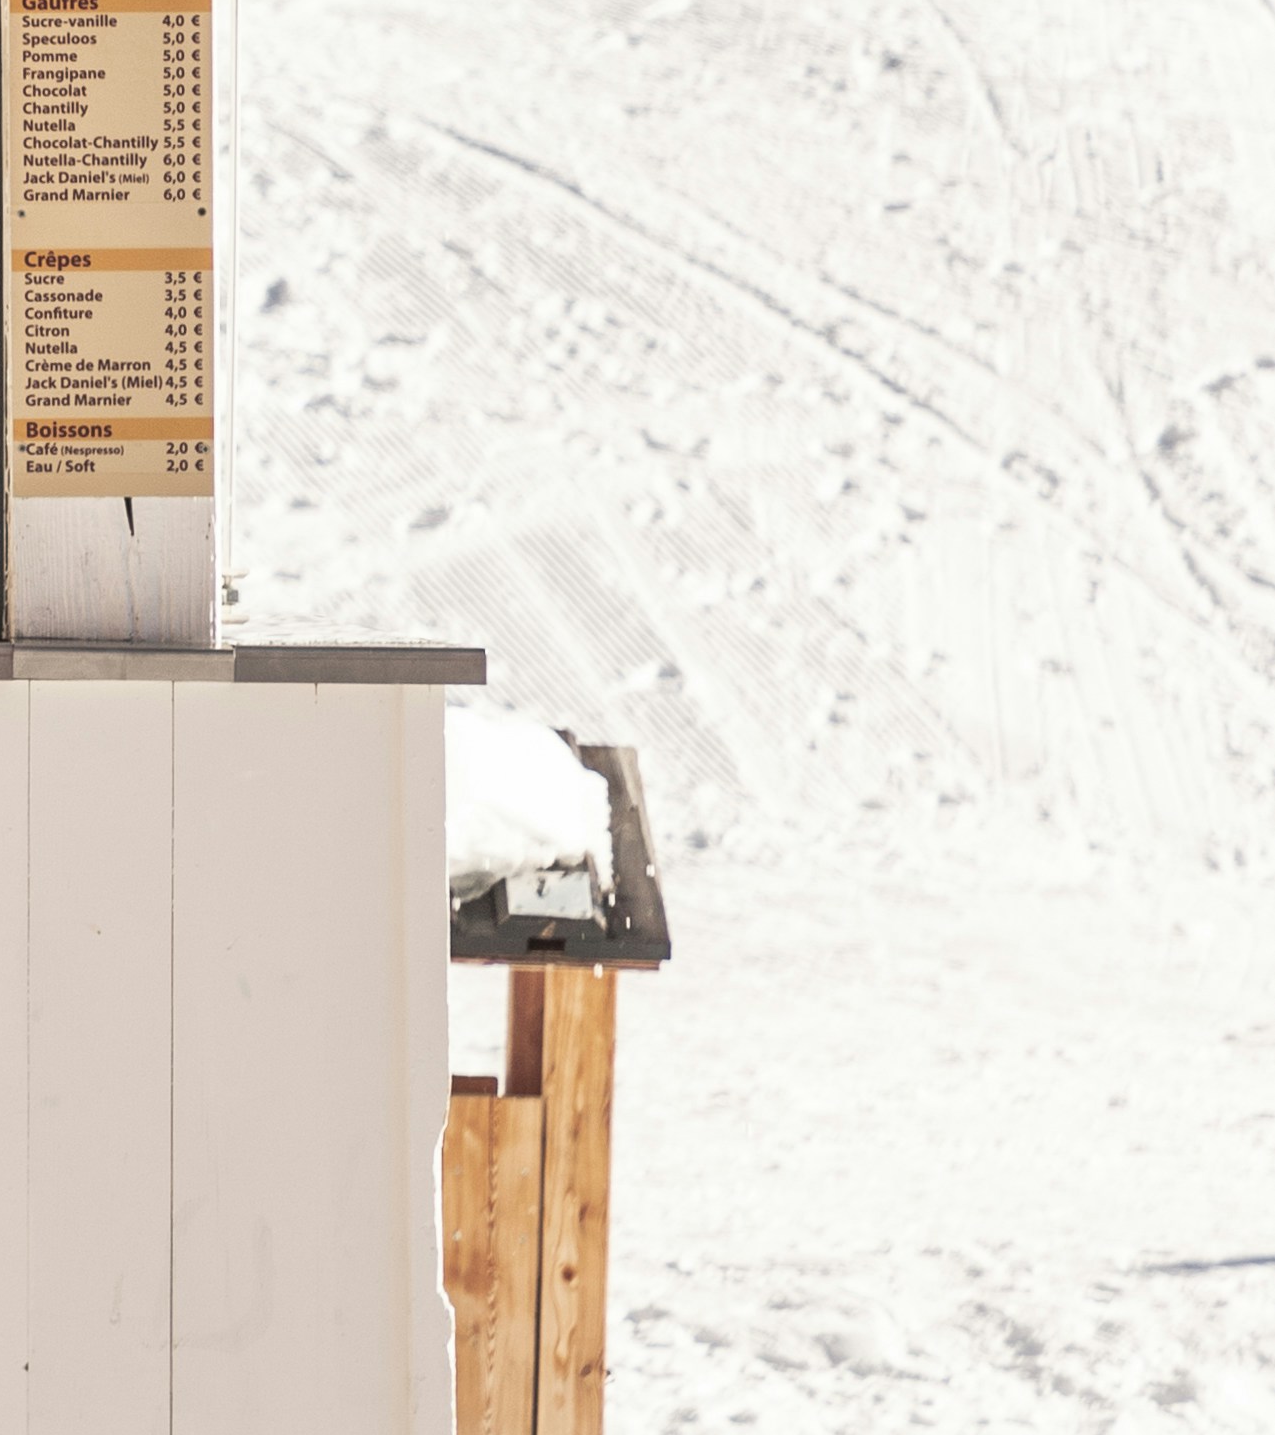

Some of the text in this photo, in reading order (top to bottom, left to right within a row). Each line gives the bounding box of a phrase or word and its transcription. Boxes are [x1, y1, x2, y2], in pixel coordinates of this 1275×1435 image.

[23, 15, 199, 28] Sucre-vanille 4,0 €
[23, 32, 200, 48] Speculoos 5,0 €
[23, 49, 200, 63] Pomme 5,0 €
[23, 67, 200, 82] Frangipane 5,0 €
[23, 84, 200, 97] Chocolat 5,0 €
[23, 102, 200, 117] Chantilly 5,0 €
[24, 119, 200, 132] Nutella 5,5 €
[23, 136, 200, 151] Chocolat-Chantilly 5,5 €
[24, 153, 200, 169] Nutella-Chantilly 6,0 €
[24, 171, 201, 184] Jack Daniel's (Miel) 6,0 €
[24, 188, 200, 202] Grand Marnier 6,0 €
[25, 251, 91, 270] Crêpes
[25, 272, 202, 285] Sucre 3,5 €
[25, 289, 202, 302] Cassonade 3,5 €
[25, 306, 202, 320] Confiture 4,0 €
[25, 324, 202, 337] Citron 4,0 €
[26, 341, 202, 354] Nutella 4,5 €
[26, 359, 202, 372] Crème de Marron 4,5 €
[26, 376, 202, 389] Jack Daniel's (Miel) 4,5 €
[26, 393, 203, 407] Grand Marnier 4,5 €
[27, 422, 112, 438] Boissons
[26, 442, 204, 457] Café (Nespresso) 2,0 €
[27, 459, 203, 473] Eau / Soft 2,0 €
